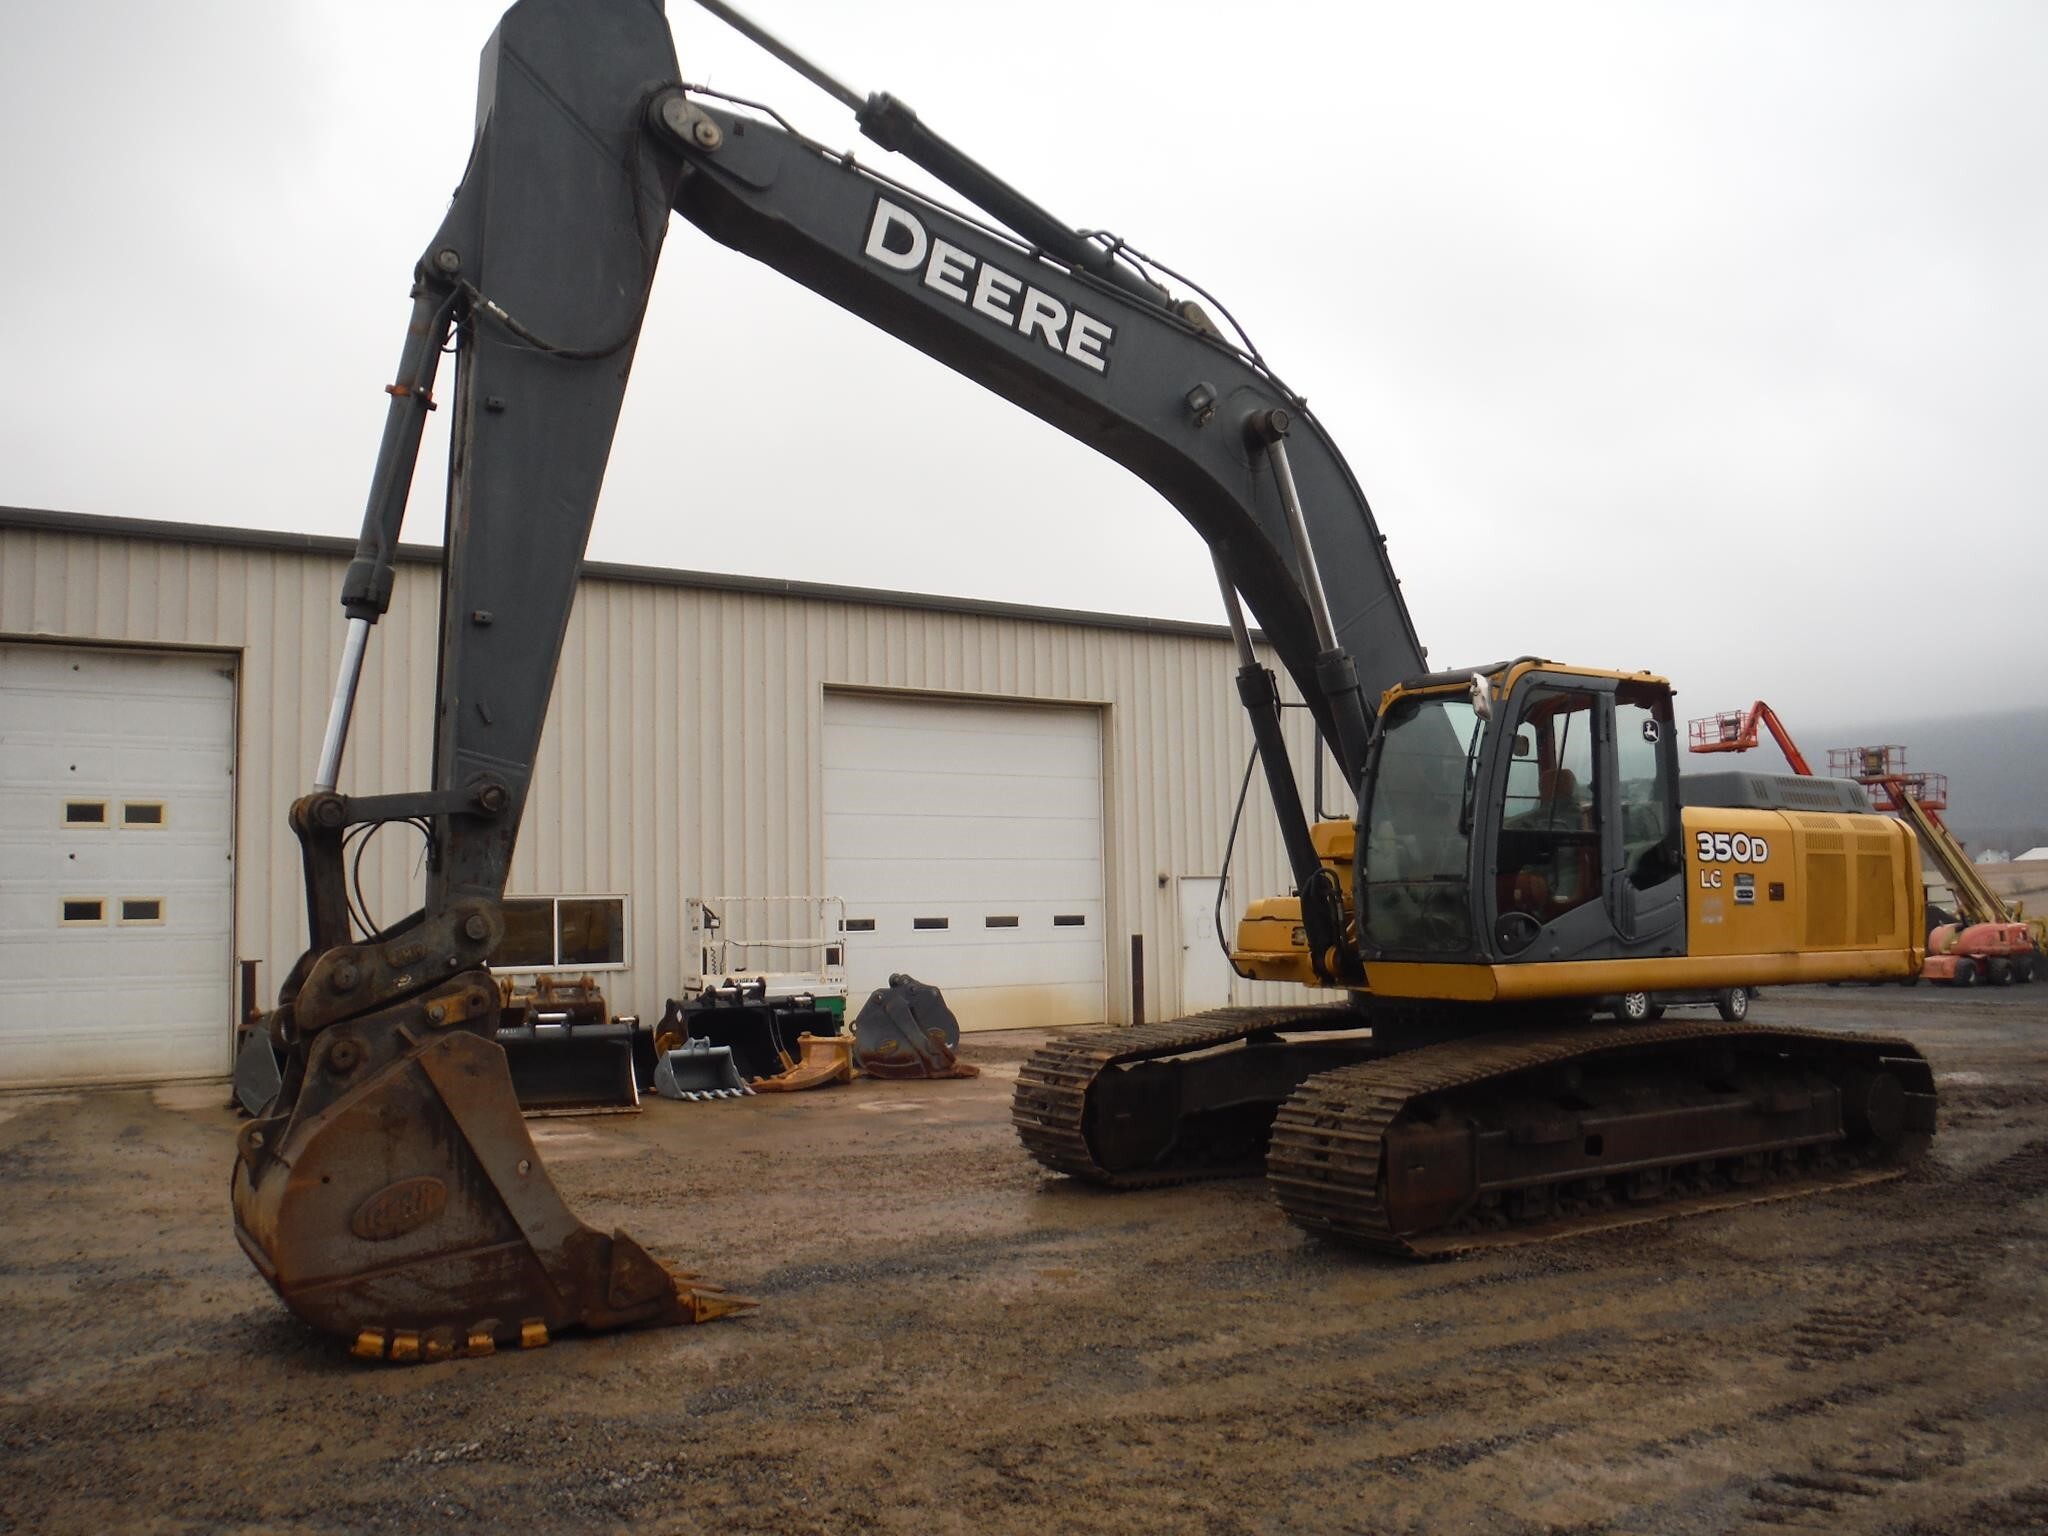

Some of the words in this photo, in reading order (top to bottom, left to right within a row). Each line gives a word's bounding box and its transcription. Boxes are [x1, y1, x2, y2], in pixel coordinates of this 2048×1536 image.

[865, 197, 1112, 372] DEERE
[1696, 831, 1768, 863] 350D
[1700, 869, 1722, 889] LC
